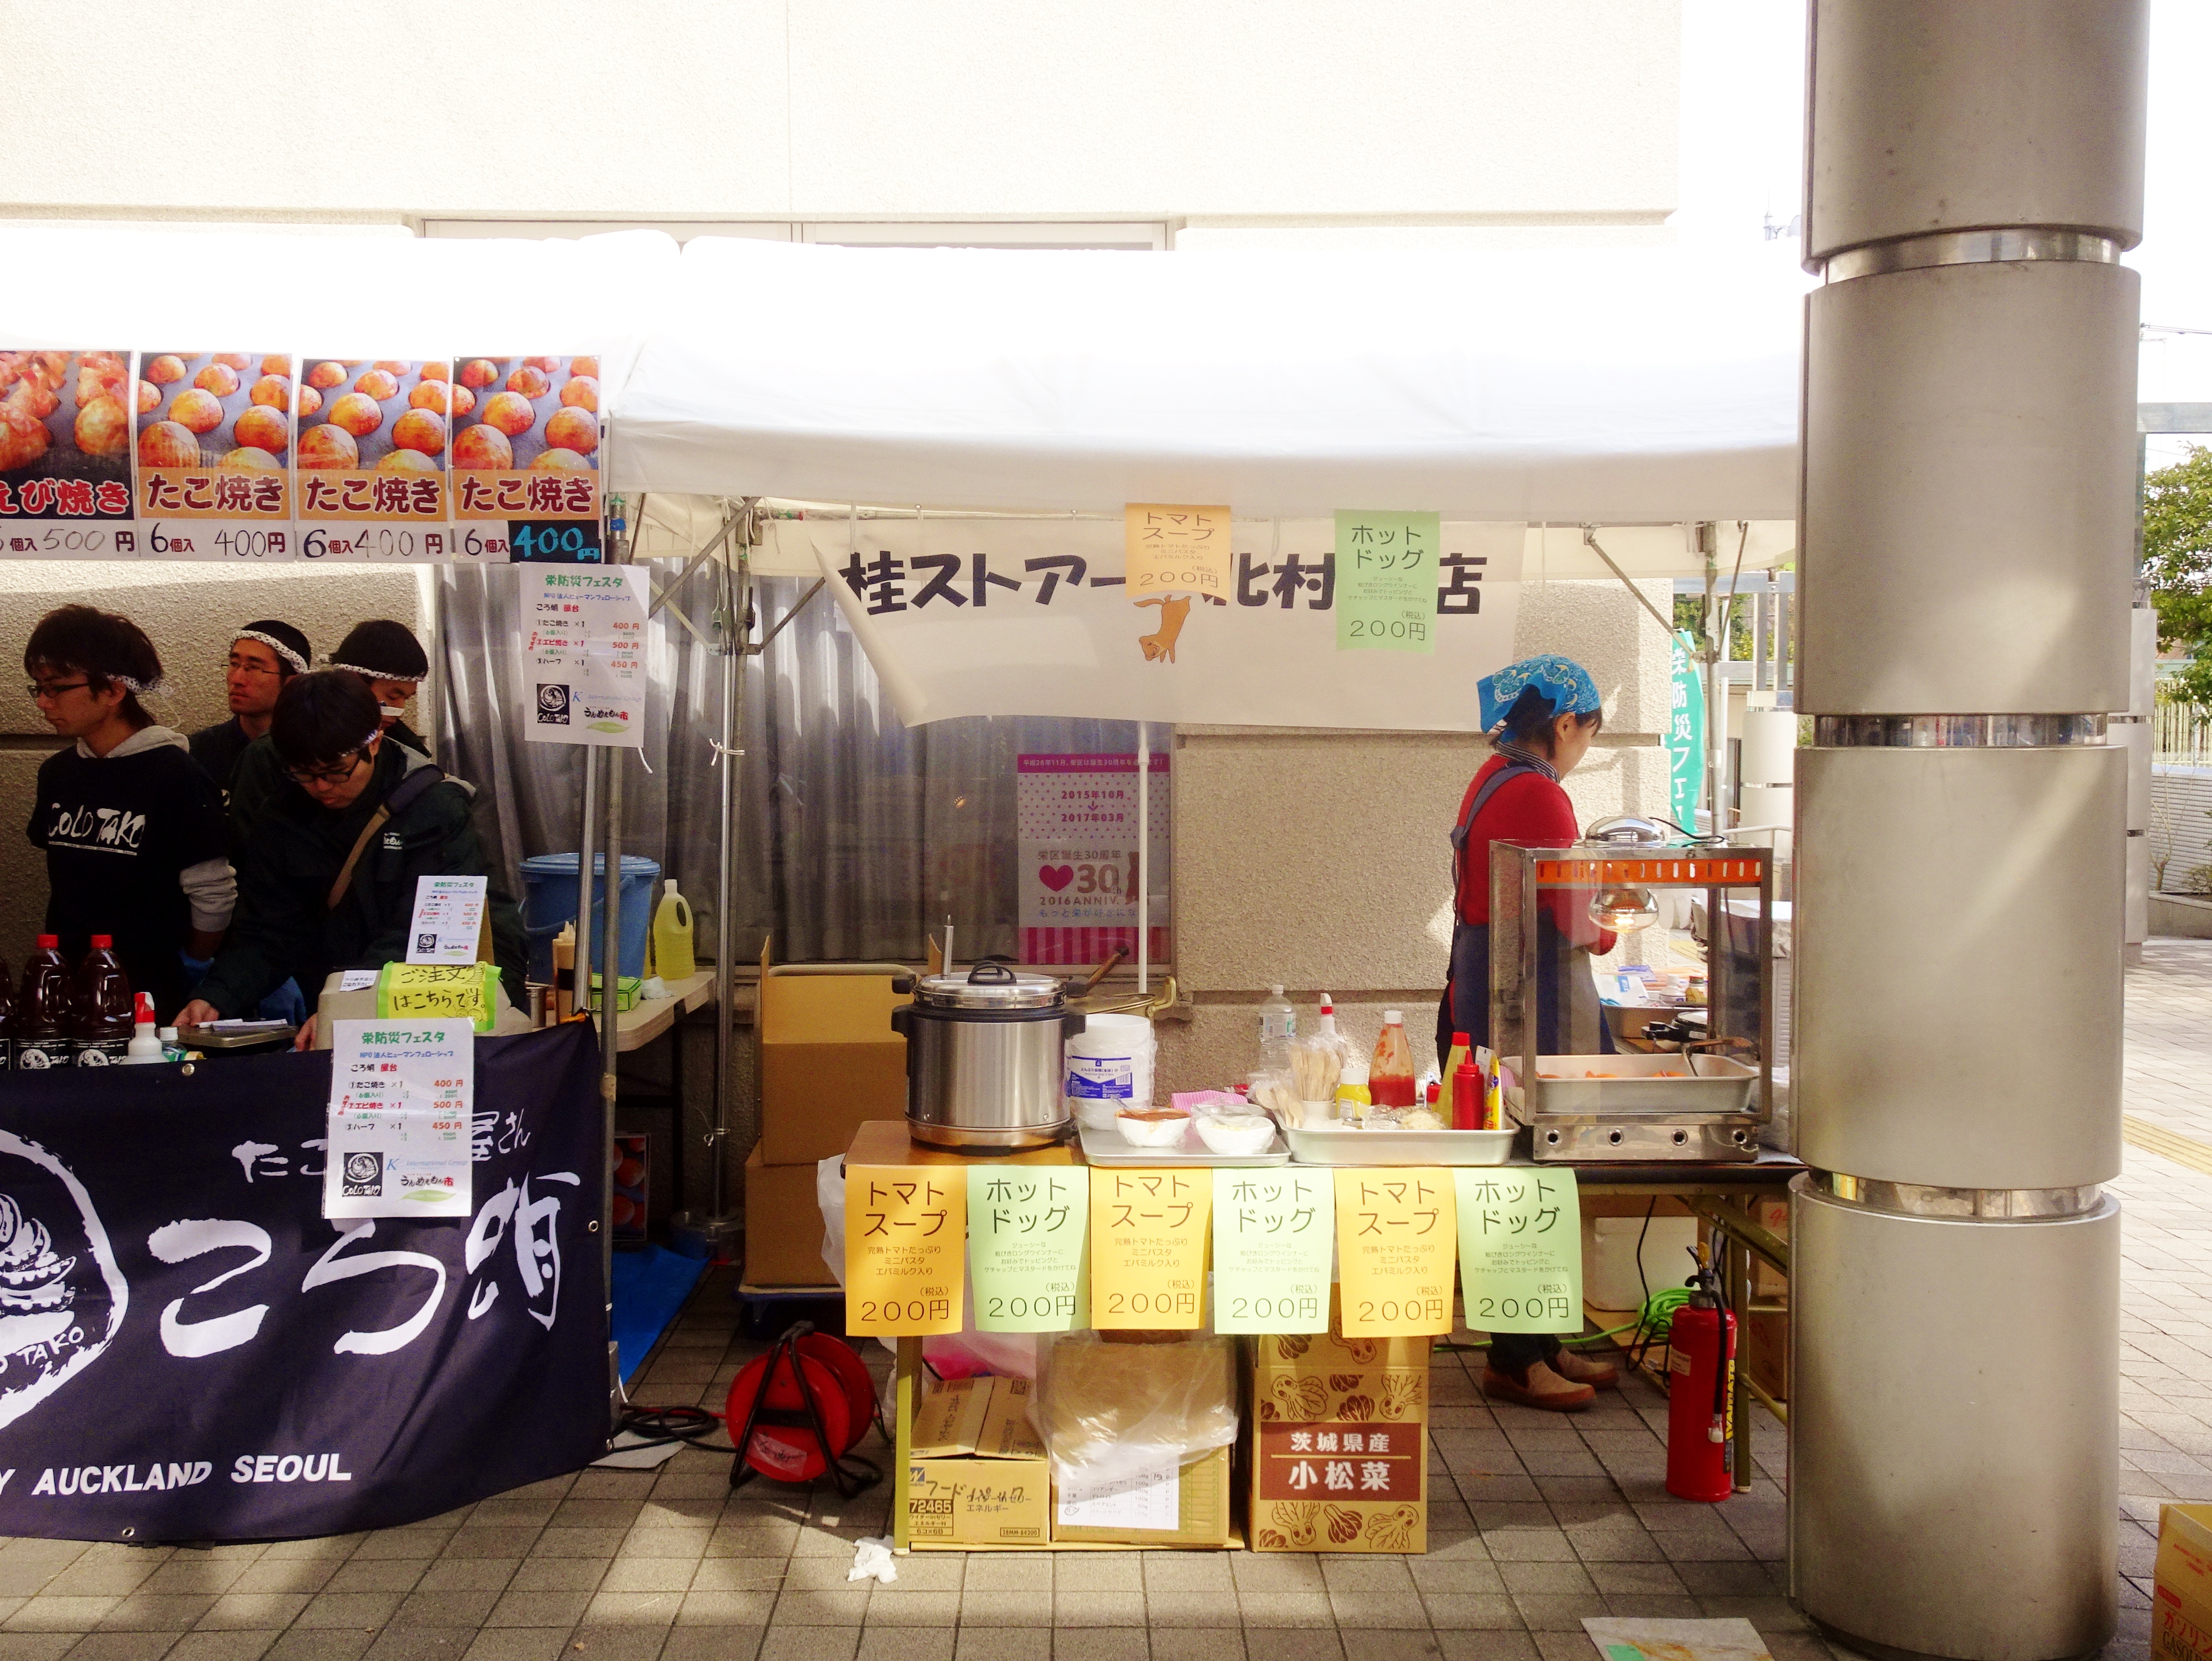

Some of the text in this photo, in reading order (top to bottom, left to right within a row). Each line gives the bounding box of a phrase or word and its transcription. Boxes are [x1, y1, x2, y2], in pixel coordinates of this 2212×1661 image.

[146, 473, 284, 512] たこ焼き
[306, 475, 441, 514] たこ焼き
[461, 476, 593, 513] たこ焼き
[1147, 512, 1212, 526] トマト
[1142, 528, 1215, 541] スープ
[1351, 524, 1421, 545] ホット
[1357, 549, 1424, 570] ドッグ
[545, 574, 623, 588] 栄防災フェスタ
[838, 550, 1488, 615] 桂ストアー 北村店
[1140, 571, 1218, 588] 200円
[564, 604, 579, 613] 屋台
[1349, 620, 1426, 641] 200円
[1061, 790, 1124, 800] 2015年10月
[1061, 813, 1124, 823] 2017年03月
[1038, 850, 1121, 860] 栄区誕生30周年
[401, 966, 467, 983] ご注文
[361, 1031, 446, 1044] 栄防災フェスタ
[380, 1064, 398, 1072] 屋台
[870, 1181, 944, 1207] トマト
[987, 1177, 1066, 1203] ホット
[1116, 1175, 1190, 1198] トマト
[1232, 1178, 1313, 1203] ホット
[1361, 1180, 1435, 1206] トマト
[1475, 1178, 1556, 1203] ホット
[864, 1210, 948, 1237] スープ
[994, 1205, 1070, 1234] ドッグ
[1111, 1202, 1194, 1228] スープ
[1239, 1207, 1316, 1233] ドッグ
[1358, 1207, 1439, 1236] スープ
[1483, 1206, 1561, 1235] ドッグ
[867, 1246, 941, 1255] 完熟トマトたっぷり
[1114, 1237, 1188, 1247] 完熟トマトたっぷり
[1131, 1248, 1173, 1257] ミニパスタ
[1361, 1244, 1436, 1253] 完熟トマトたっぷり
[884, 1256, 925, 1265] ミニパスタ
[1379, 1255, 1420, 1265] ミニパスタ
[920, 1287, 949, 1296] (税込)
[1045, 1282, 1076, 1293] (税込)
[1167, 1279, 1195, 1290] (税込)
[1289, 1283, 1319, 1295] (税込)
[1415, 1285, 1443, 1296] (税込)
[1536, 1283, 1568, 1294] (税込)
[861, 1299, 949, 1322] 200円
[988, 1295, 1077, 1318] 200円
[1109, 1292, 1195, 1314] 200円
[1232, 1297, 1318, 1319] 200円
[1358, 1298, 1443, 1322] 200円
[1479, 1297, 1569, 1318] 200円
[16, 1326, 85, 1366] TAKO
[1290, 1432, 1390, 1453] 茨城県産
[32, 1460, 213, 1497] AUCKLAND
[231, 1453, 352, 1483] SEOUL
[1288, 1460, 1391, 1490] 小松菜
[909, 1499, 953, 1513] 72465
[966, 1504, 1009, 1512] エネルギー
